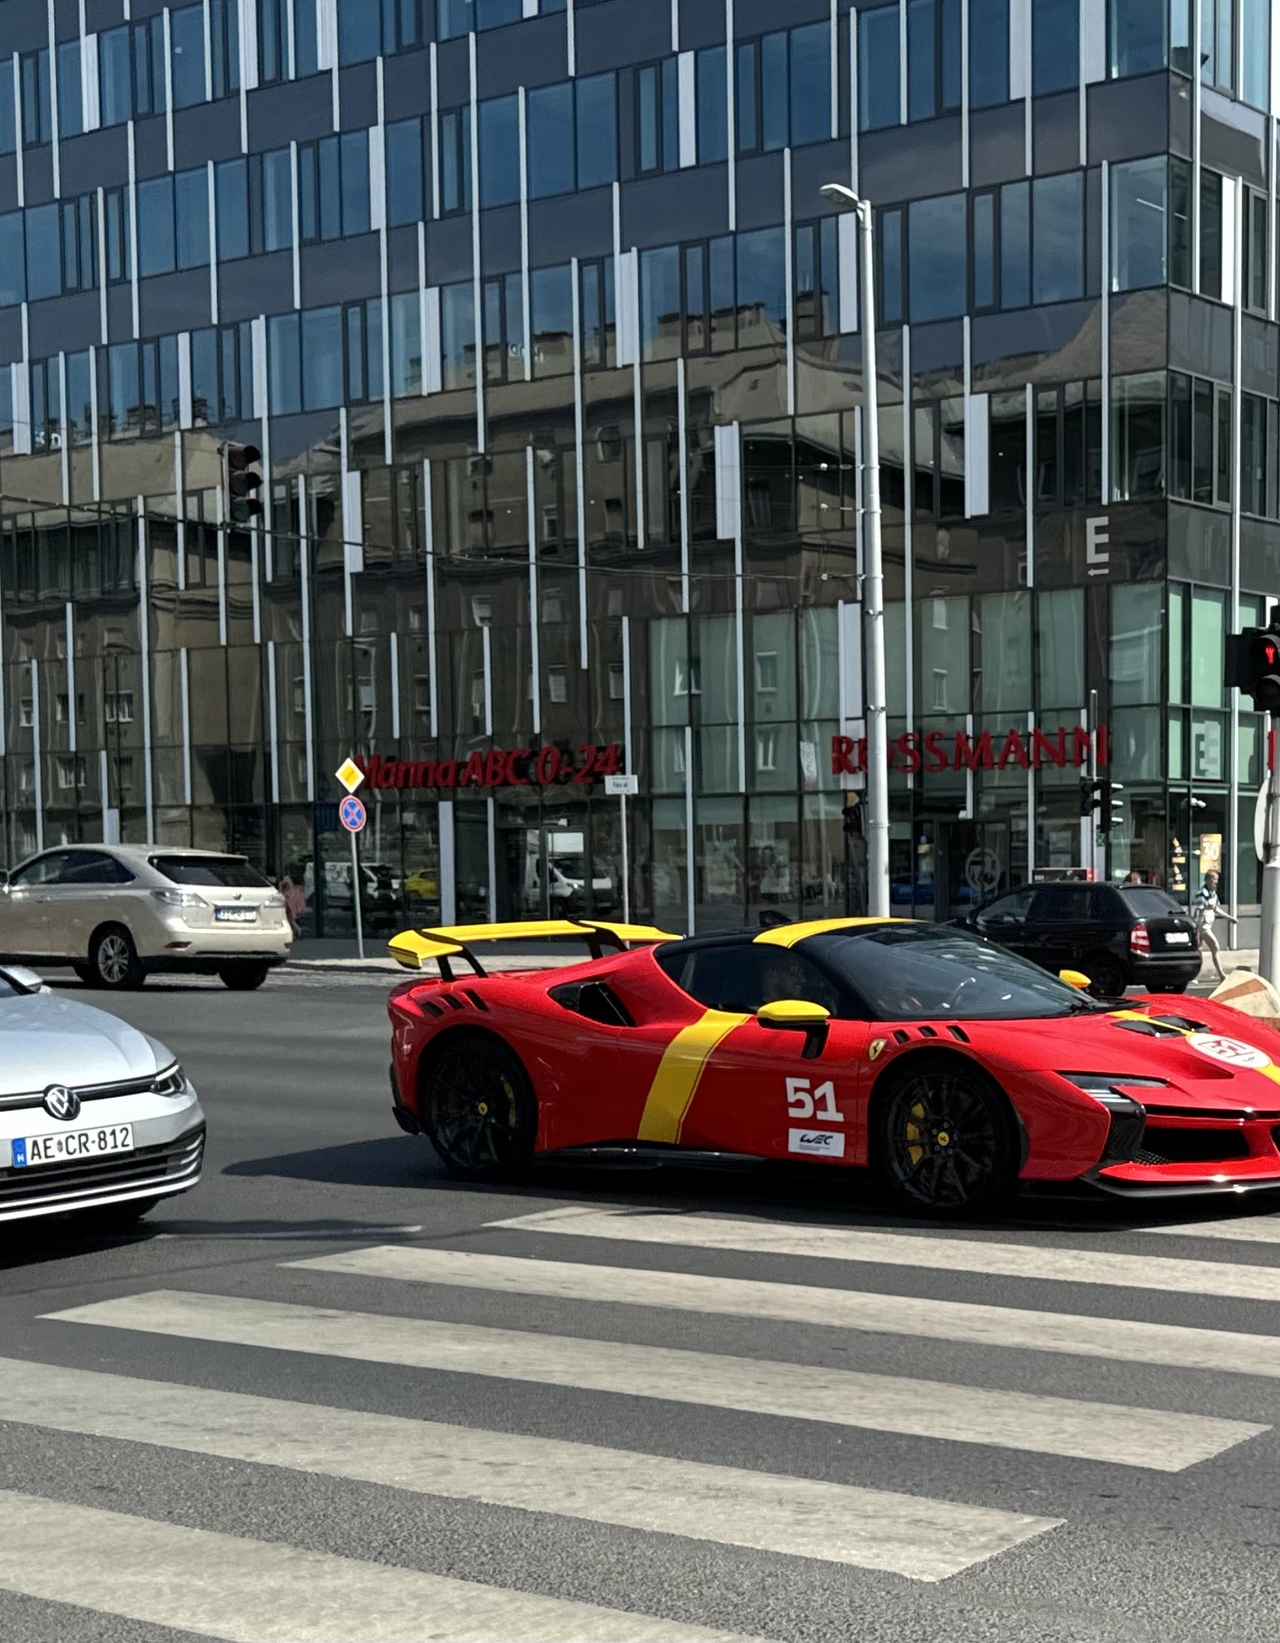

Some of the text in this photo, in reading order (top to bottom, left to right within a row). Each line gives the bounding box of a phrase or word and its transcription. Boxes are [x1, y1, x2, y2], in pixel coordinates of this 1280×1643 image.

[1086, 516, 1109, 564] E
[354, 745, 621, 789] Manna ABC 0-24
[786, 1077, 844, 1122] 51
[799, 1133, 834, 1146] WEC
